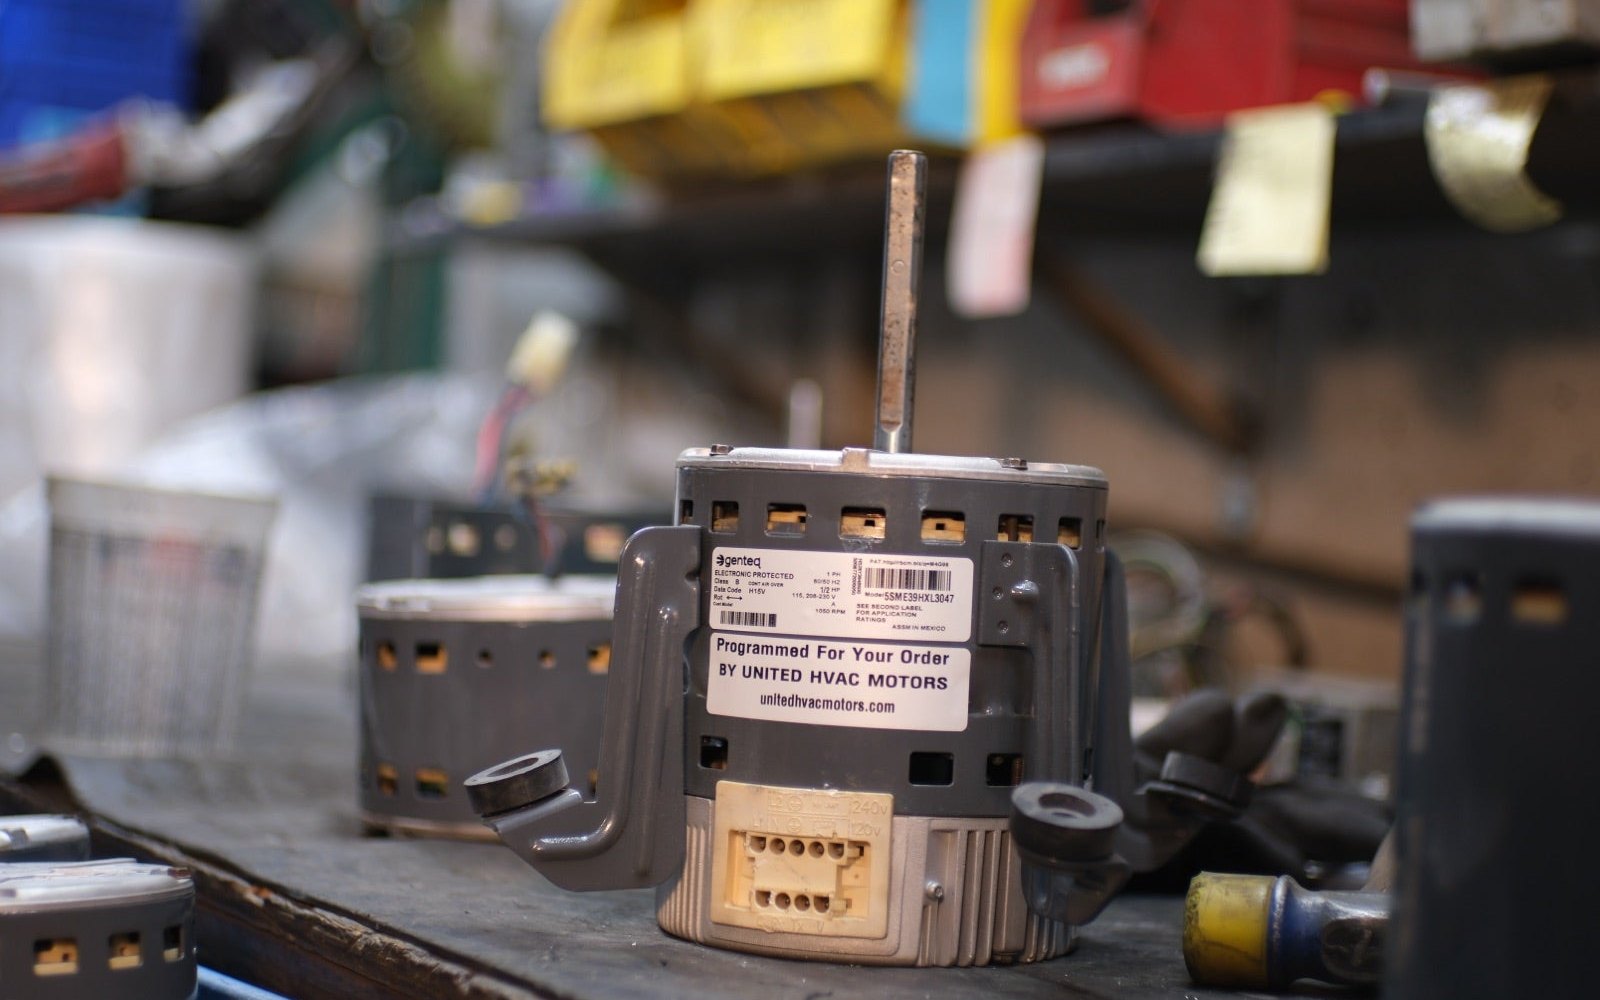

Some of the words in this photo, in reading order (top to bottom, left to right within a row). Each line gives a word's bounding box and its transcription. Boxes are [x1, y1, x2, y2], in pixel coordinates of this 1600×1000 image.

[725, 556, 761, 568] genteq
[714, 570, 751, 578] ELECTRONIC
[884, 592, 954, 603] 5SME39HXL3047
[717, 638, 809, 658] Programmed
[817, 645, 845, 660] For
[852, 647, 893, 663] Your
[900, 649, 950, 665] Order
[719, 663, 736, 677] BY
[742, 665, 802, 682] UNITED
[810, 671, 859, 686] HVAC
[868, 674, 948, 690] MOTORS
[760, 693, 895, 713] unitedhvacmotors.com
